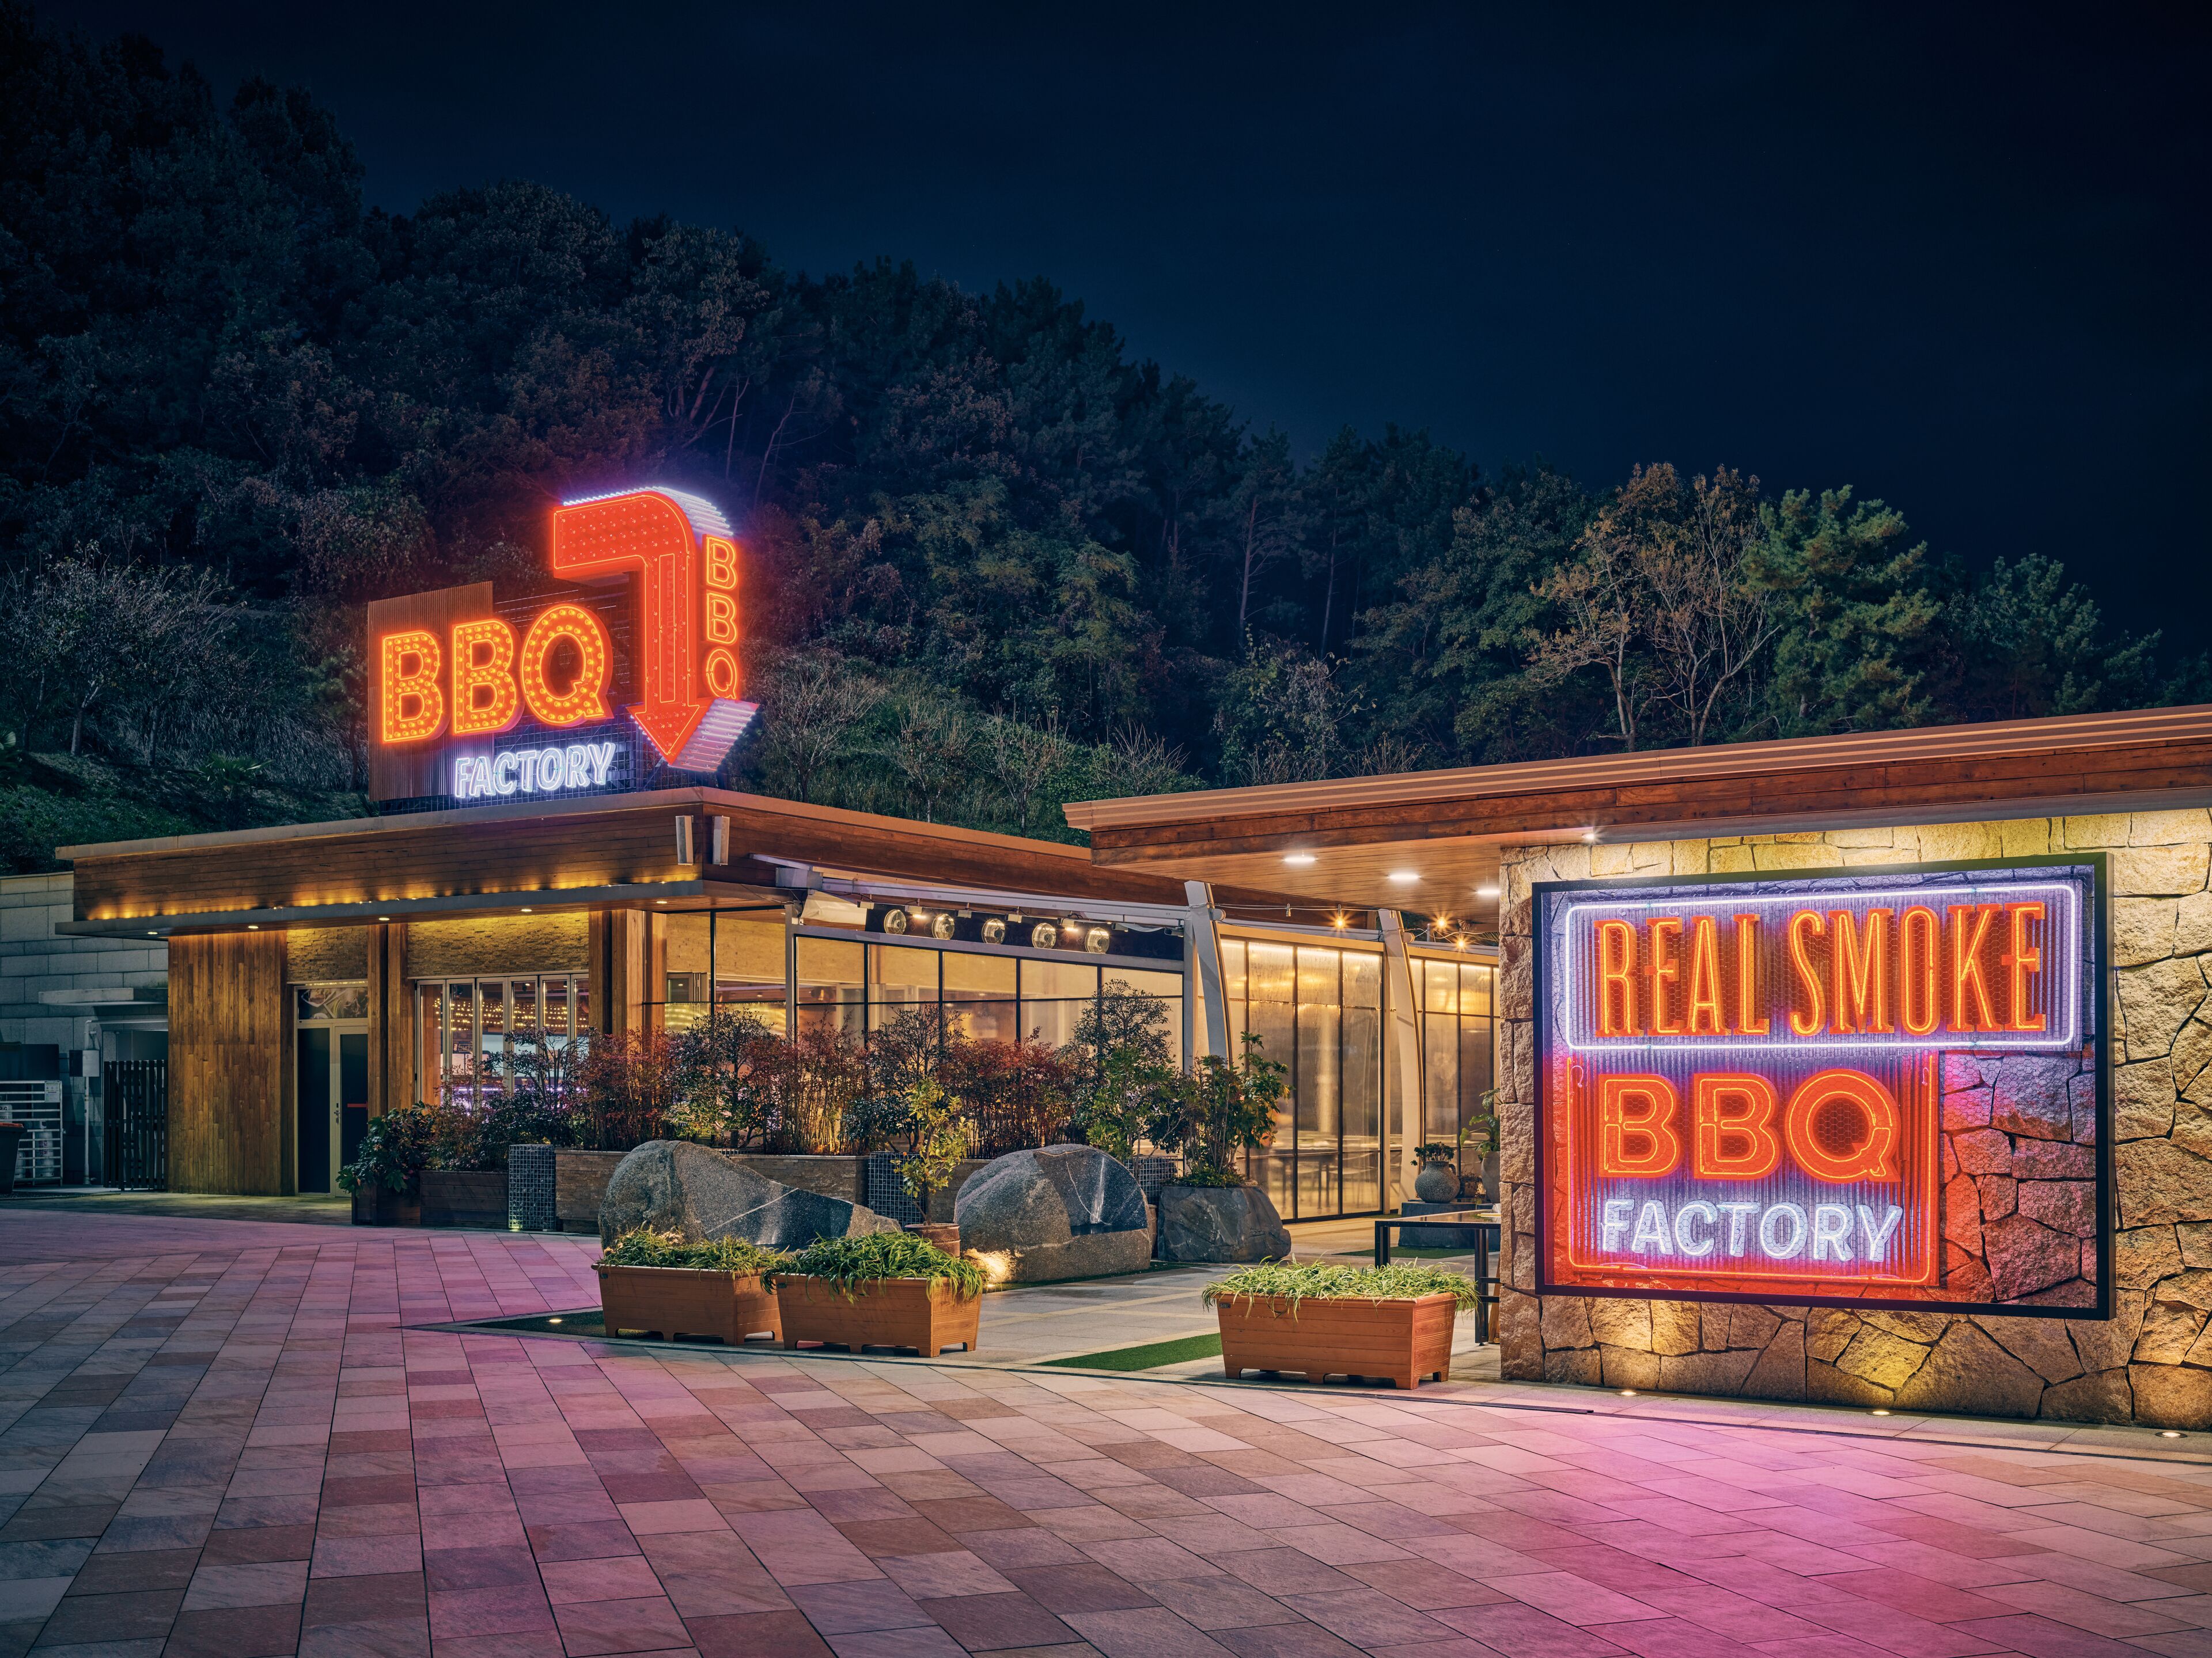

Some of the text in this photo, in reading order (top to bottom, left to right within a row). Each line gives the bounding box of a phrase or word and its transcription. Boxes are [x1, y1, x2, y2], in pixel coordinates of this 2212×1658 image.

[381, 605, 613, 743] BBQ
[706, 535, 738, 700] BBQ
[454, 742, 616, 798] FACTORY
[1594, 901, 2046, 1038] REAL SMOKE
[1597, 1068, 1902, 1183] BBQ
[1601, 1198, 1903, 1262] FACTORY
